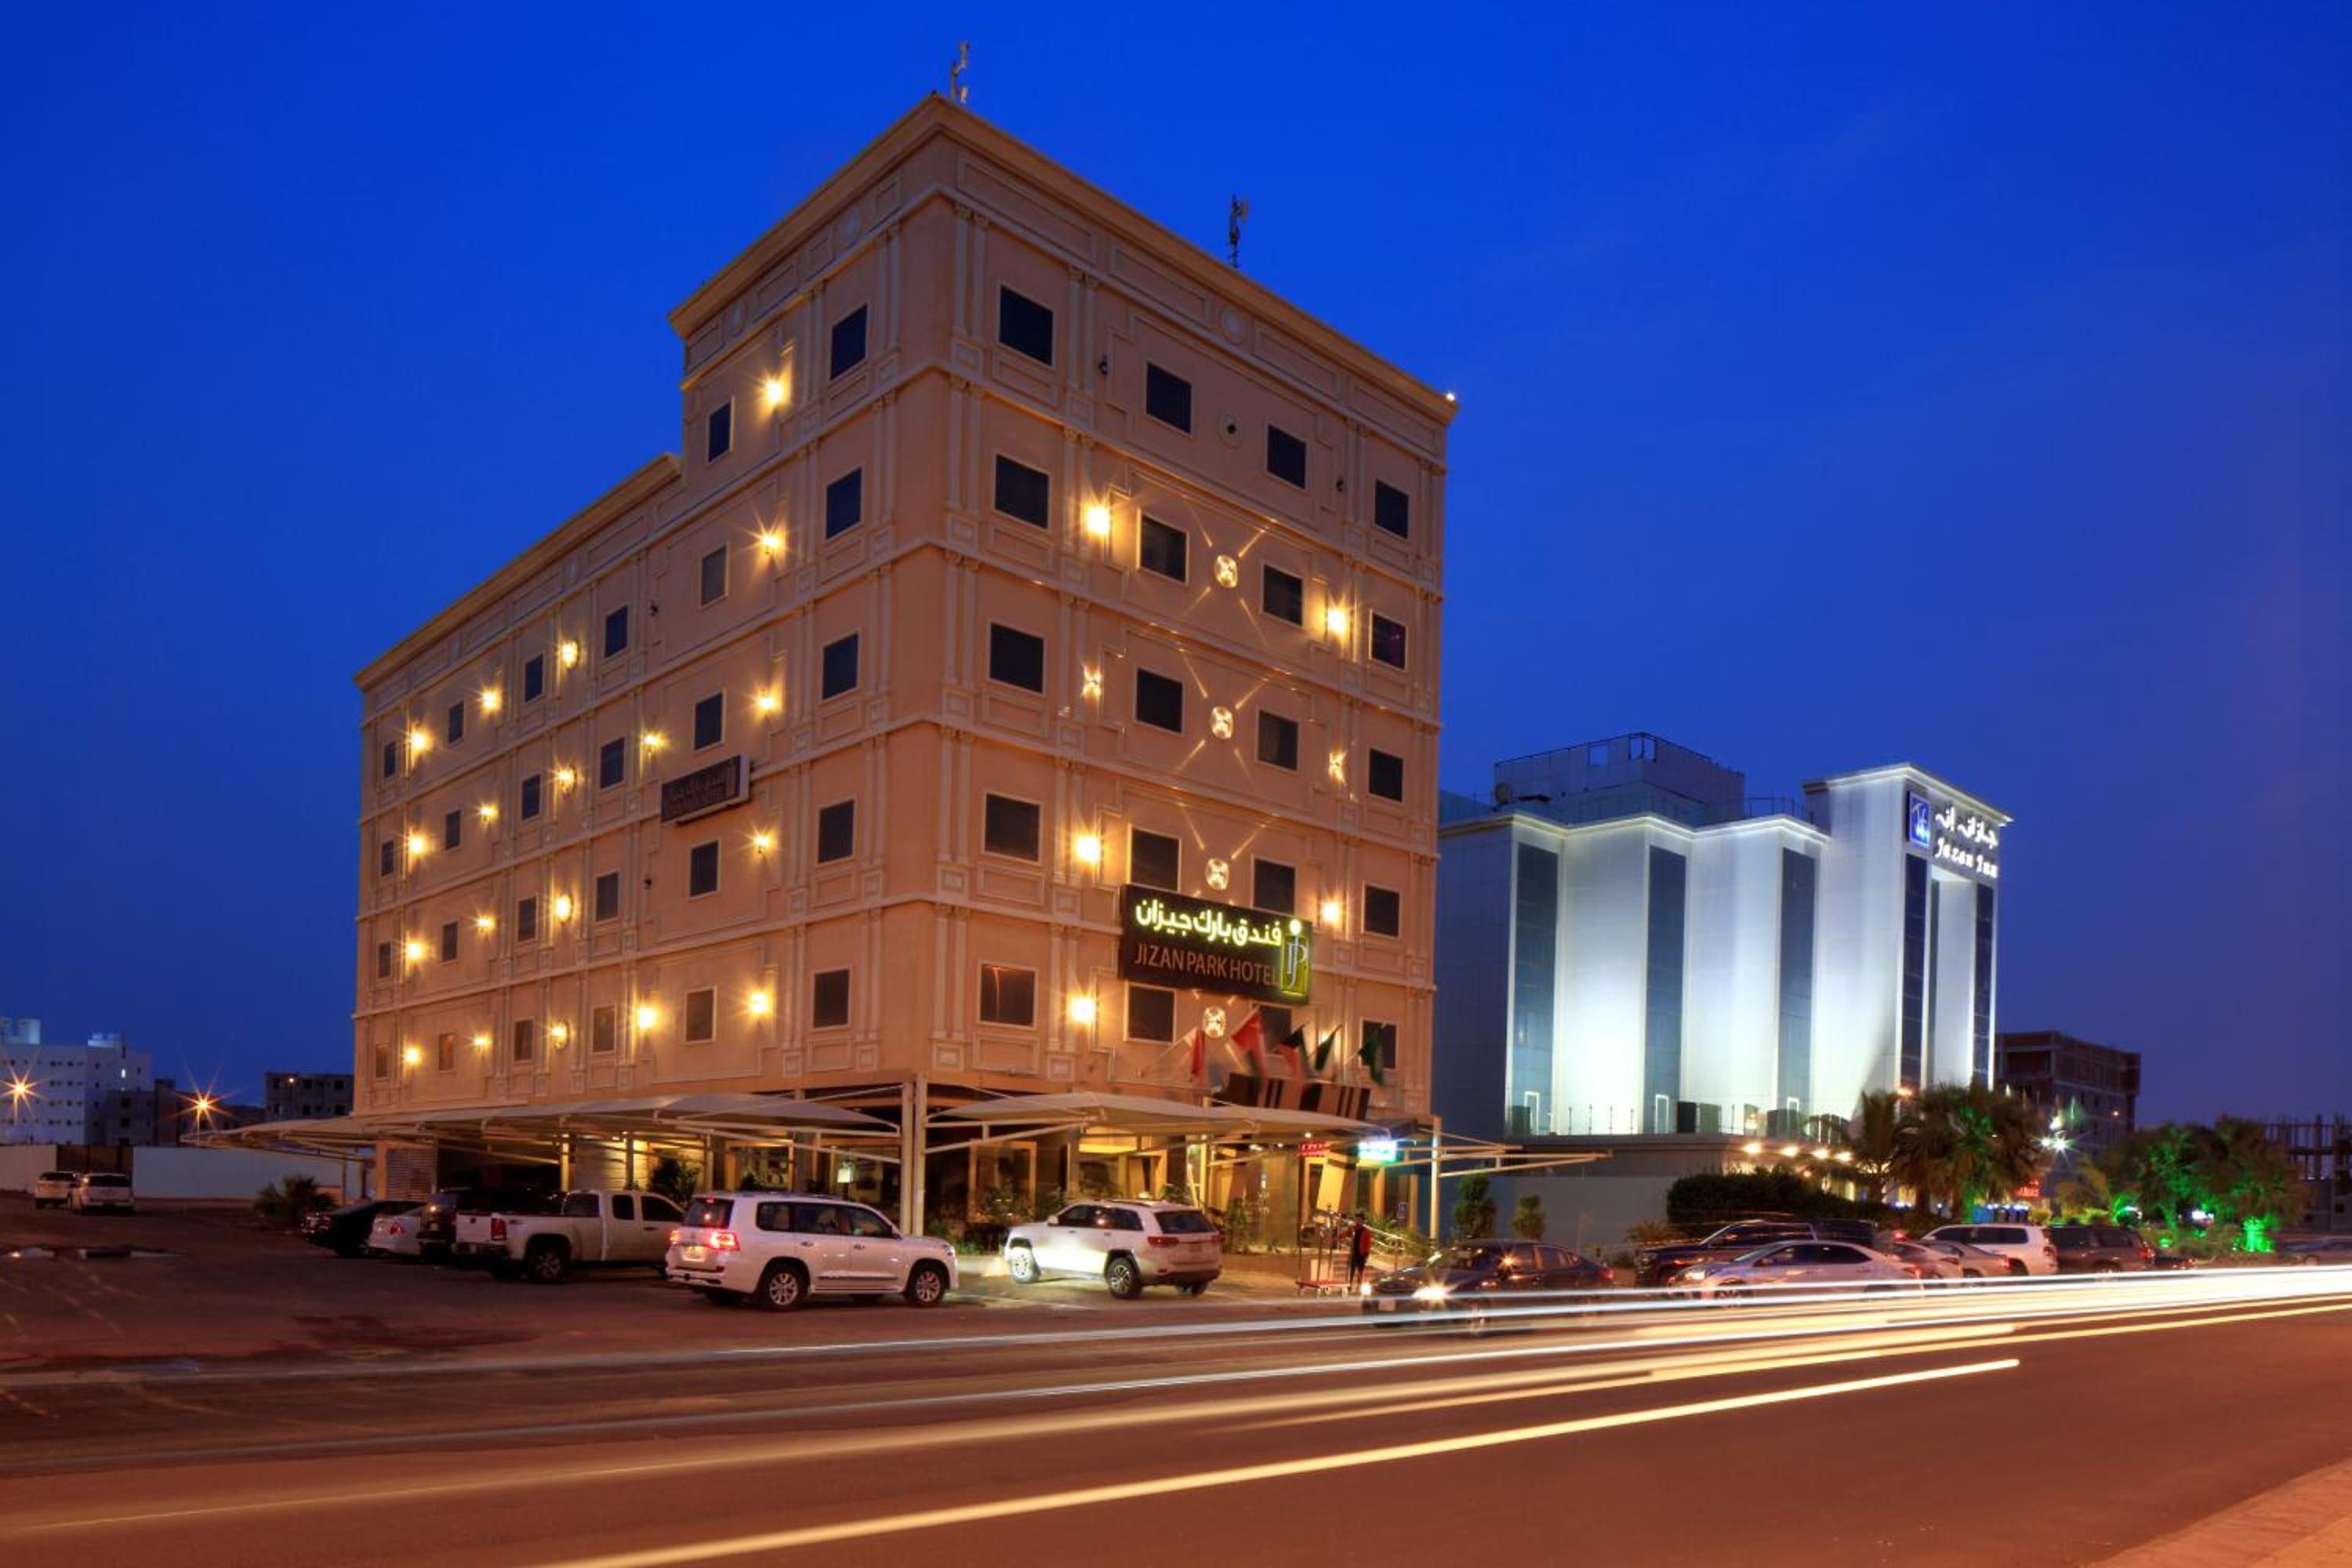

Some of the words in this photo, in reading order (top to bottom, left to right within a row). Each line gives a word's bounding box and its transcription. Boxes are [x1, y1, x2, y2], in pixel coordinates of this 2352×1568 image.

[1935, 837, 1974, 868] Jazan
[1976, 855, 1998, 878] Inn
[1135, 899, 1192, 936] جيزان
[1192, 909, 1232, 944] بارك
[1232, 918, 1282, 946] فندق
[1134, 942, 1184, 971] JIZAN
[1186, 952, 1227, 978] PARK
[1229, 958, 1280, 986] HOTEL
